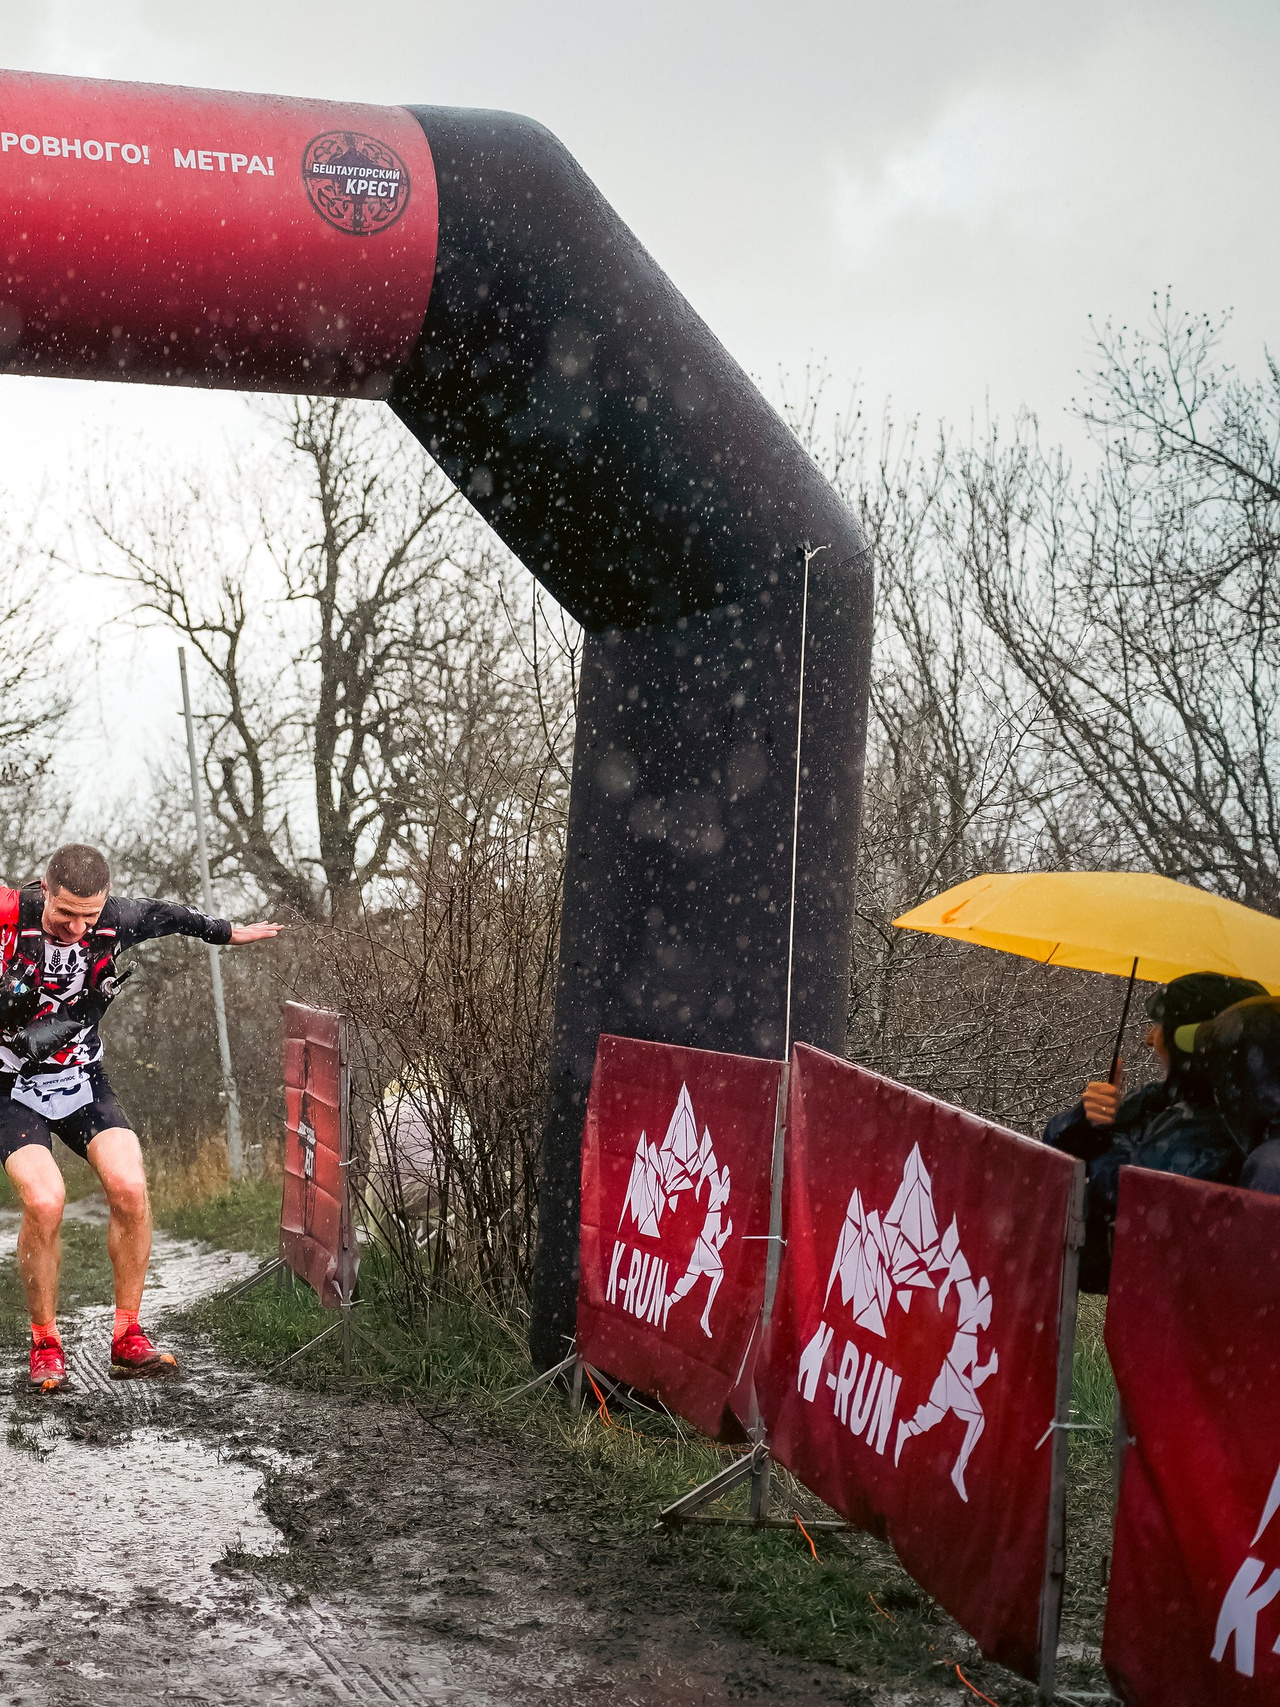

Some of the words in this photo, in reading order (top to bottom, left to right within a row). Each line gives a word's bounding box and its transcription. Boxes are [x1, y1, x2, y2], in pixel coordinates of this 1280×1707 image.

[0, 132, 151, 165] РОВНОГО!
[173, 147, 275, 177] МЕТРА!
[312, 163, 401, 180] БЕШТАУГОРСКИЙ
[345, 178, 399, 198] КРЕСТ
[606, 1239, 670, 1327] K-RUN
[797, 1320, 903, 1456] K-RUN
